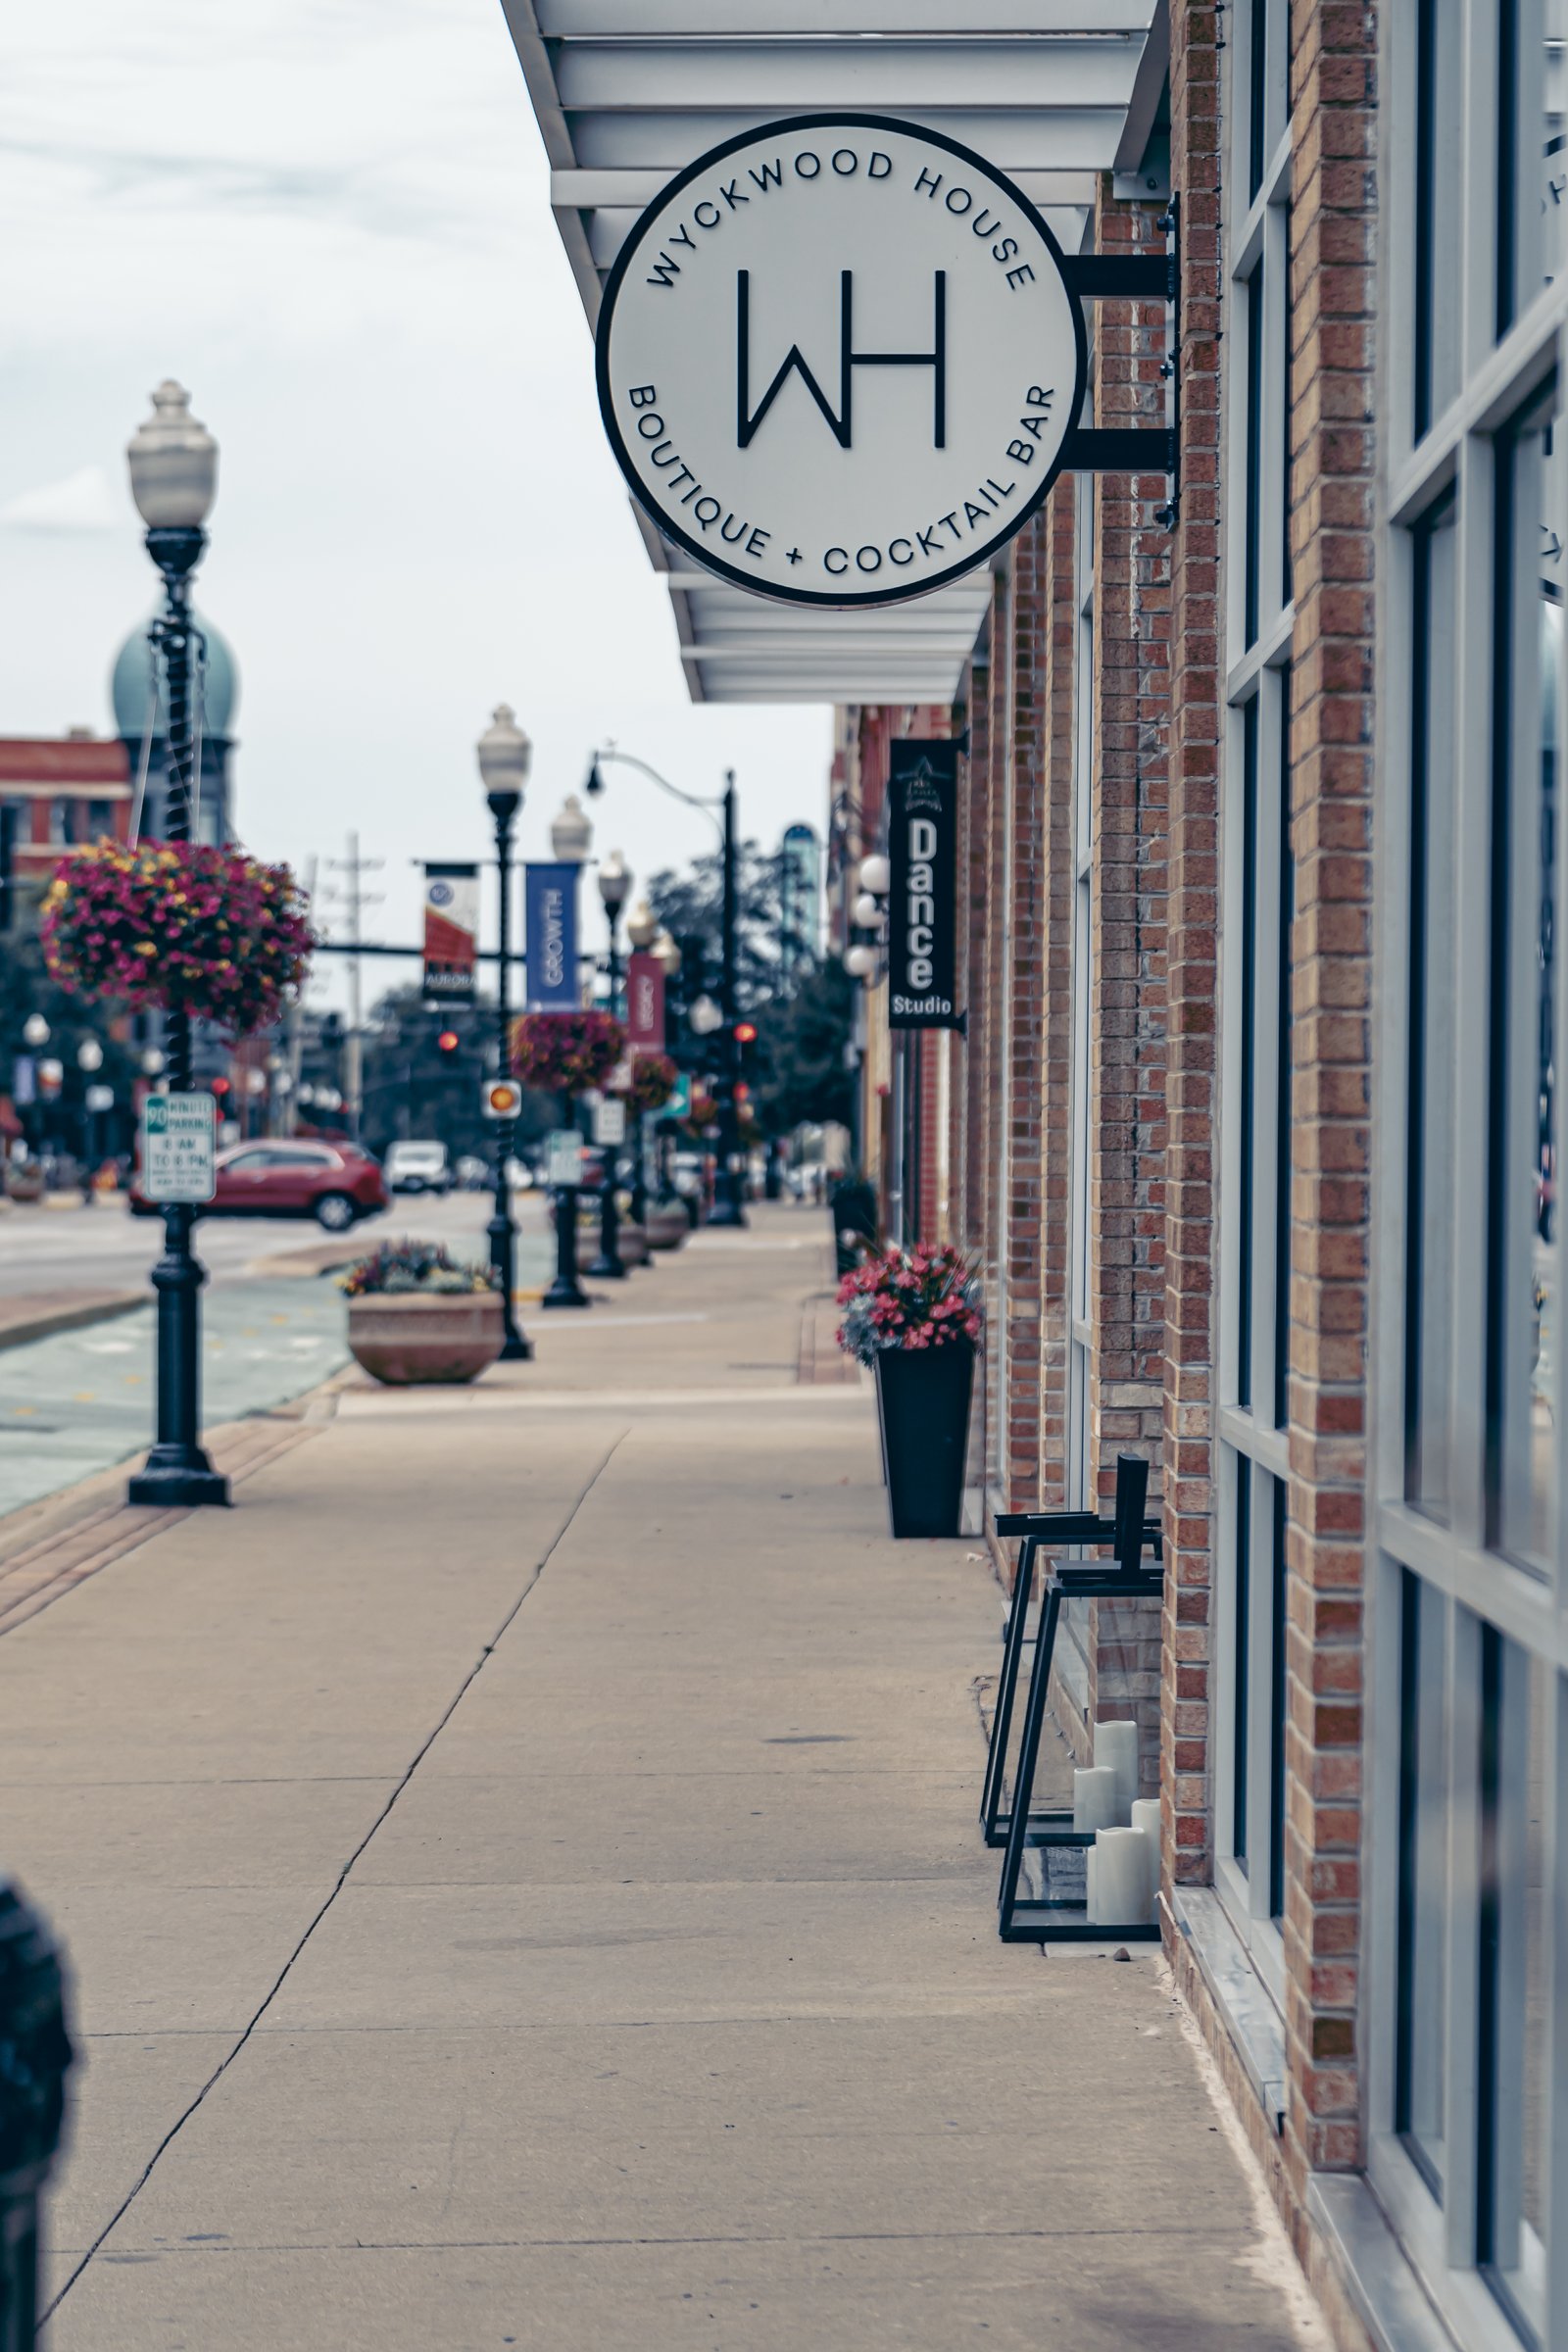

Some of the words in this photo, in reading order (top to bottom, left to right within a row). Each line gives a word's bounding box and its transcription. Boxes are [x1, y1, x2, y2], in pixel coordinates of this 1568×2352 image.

[646, 149, 893, 288] WYCKWOOD
[913, 167, 1036, 290] HOUSE
[737, 269, 947, 449] WH
[628, 384, 771, 558] BOUTIQUE
[785, 547, 803, 565] +
[823, 478, 1016, 574] COCKTAIL
[1005, 385, 1054, 466] BAR
[544, 888, 564, 988] GROWTH
[906, 817, 938, 990] Dance
[426, 973, 477, 987] AURORA
[893, 995, 952, 1015] Studio
[148, 1105, 167, 1127] 90
[169, 1117, 212, 1131] PARKING
